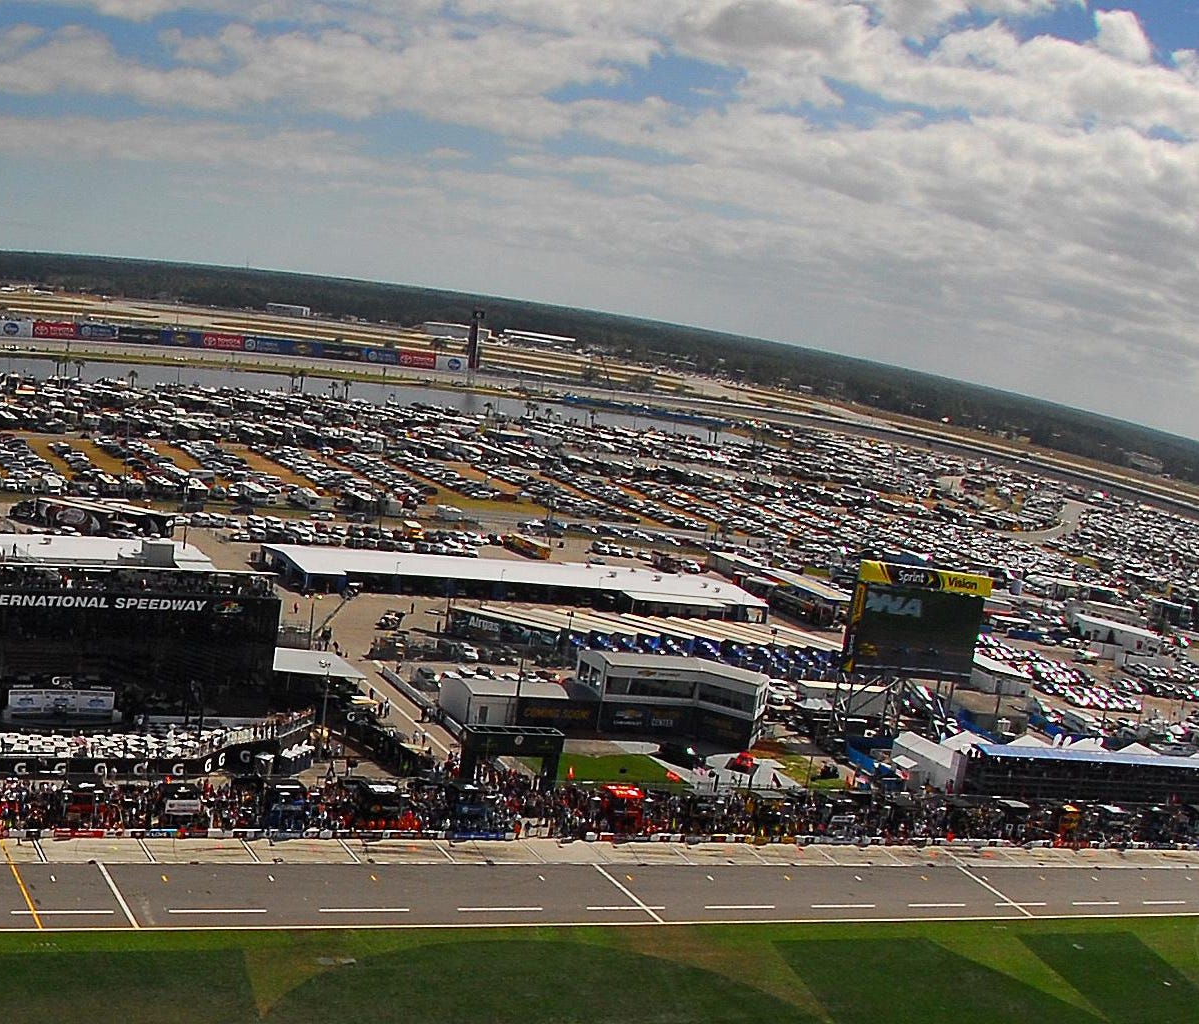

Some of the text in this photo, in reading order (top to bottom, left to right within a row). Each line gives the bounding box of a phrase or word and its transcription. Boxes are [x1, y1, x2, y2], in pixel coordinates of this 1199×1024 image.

[899, 570, 977, 590] Sprint Vision
[114, 597, 207, 612] SPEEDWAY
[468, 616, 500, 632] Airgas
[347, 712, 356, 721] G
[218, 752, 226, 766] G
[240, 750, 251, 763] G
[14, 762, 27, 774] G
[54, 762, 66, 775] G
[94, 763, 107, 775] G
[172, 763, 184, 775] G
[205, 760, 212, 773] G
